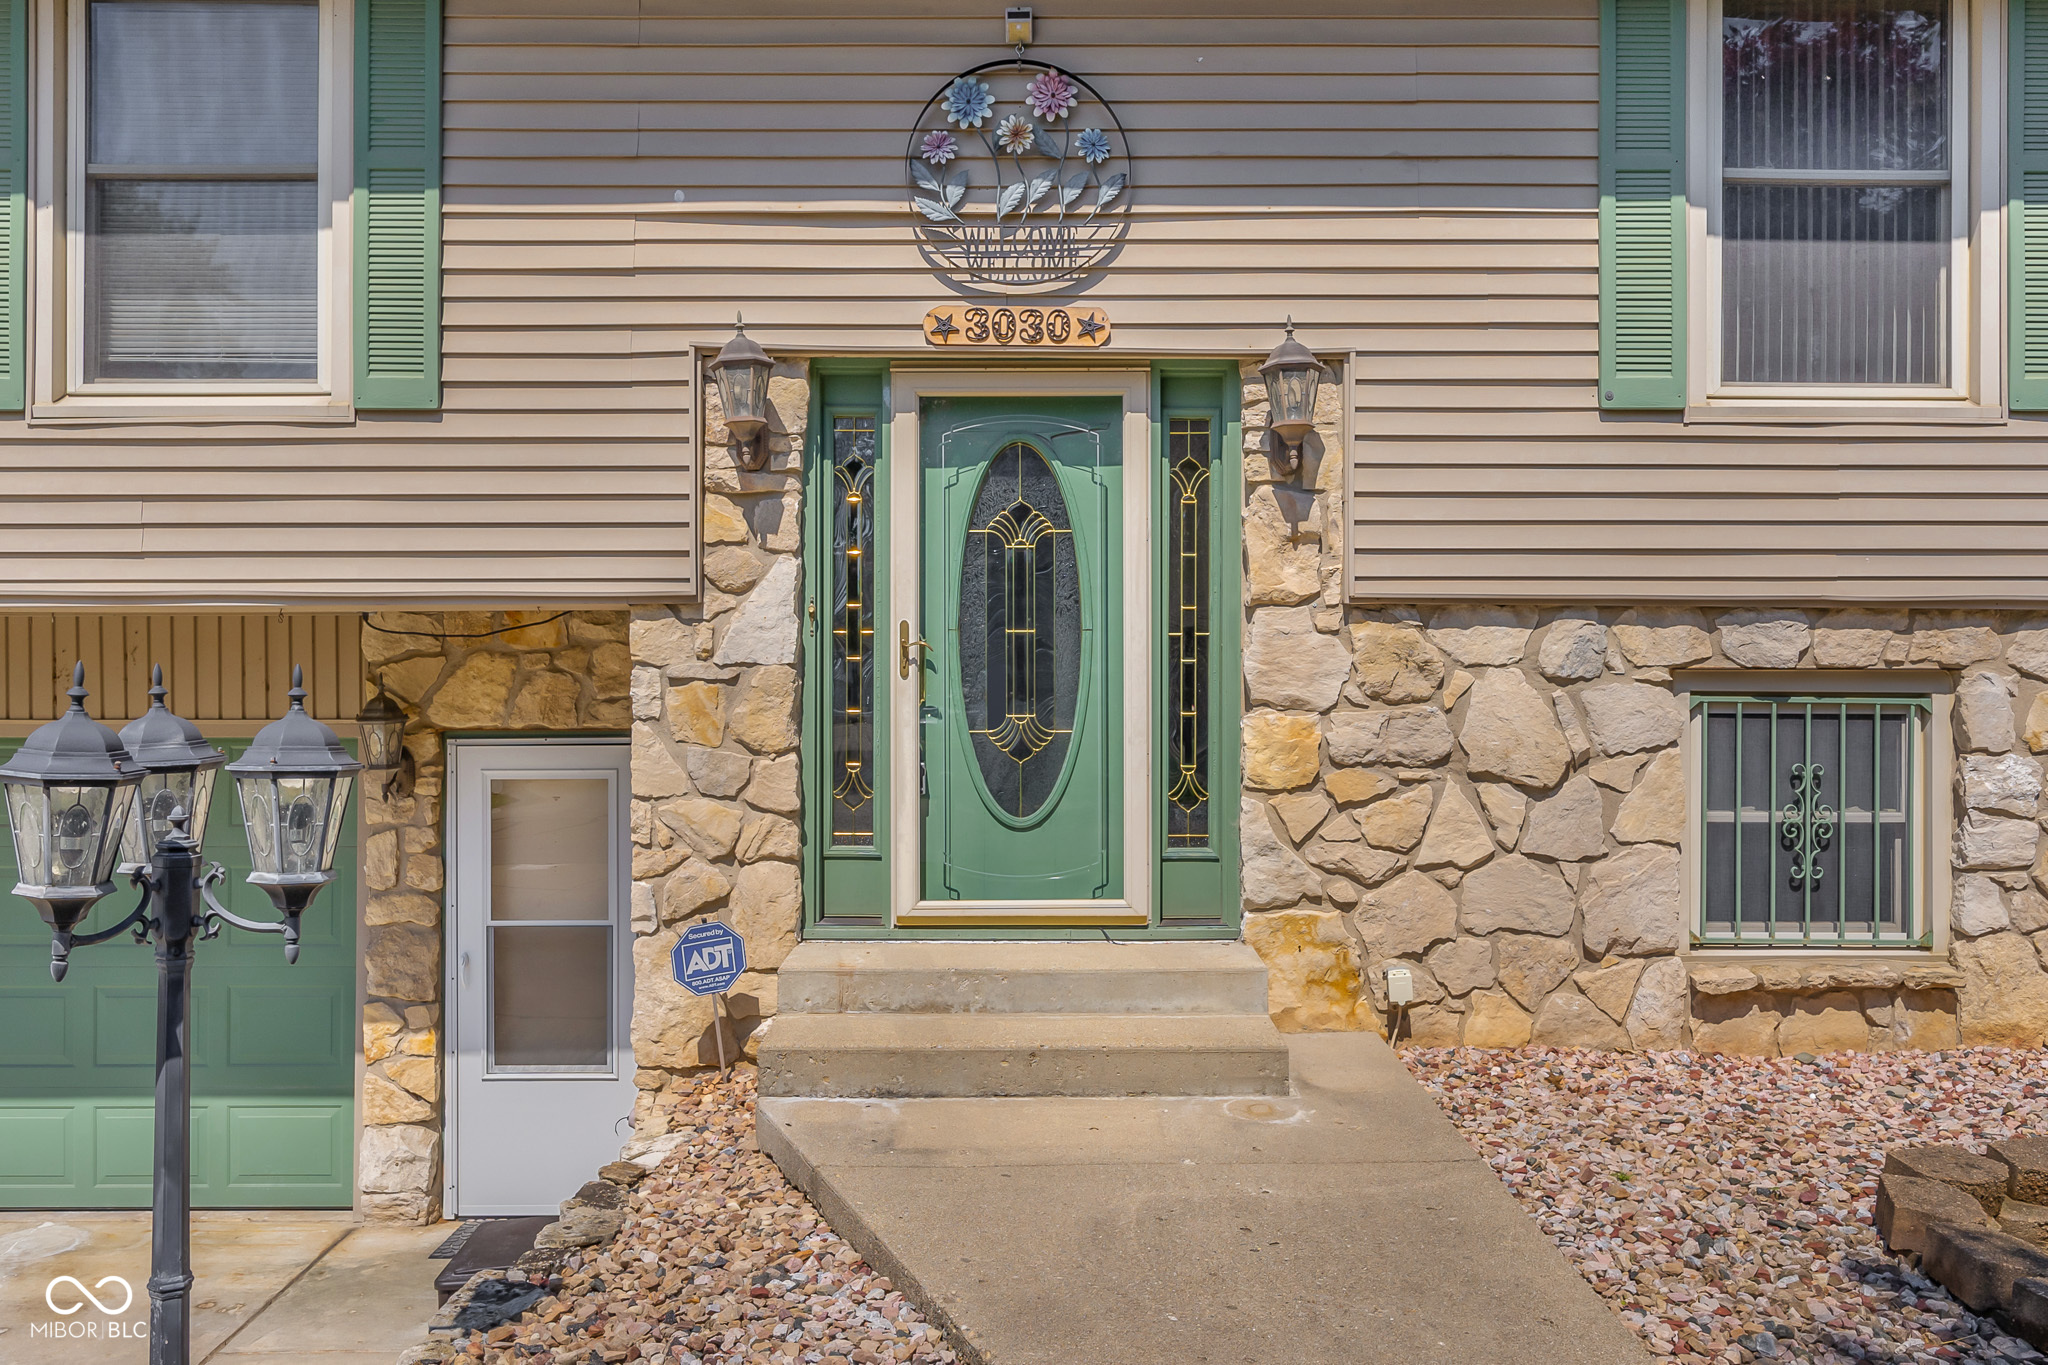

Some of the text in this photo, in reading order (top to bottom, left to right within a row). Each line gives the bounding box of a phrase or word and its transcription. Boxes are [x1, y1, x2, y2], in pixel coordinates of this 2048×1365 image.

[963, 226, 1078, 256] WELCOME
[964, 307, 1071, 344] 3030
[688, 928, 724, 940] Secured by
[686, 943, 732, 975] ADT
[691, 975, 731, 987] 800.ADT.ASAP
